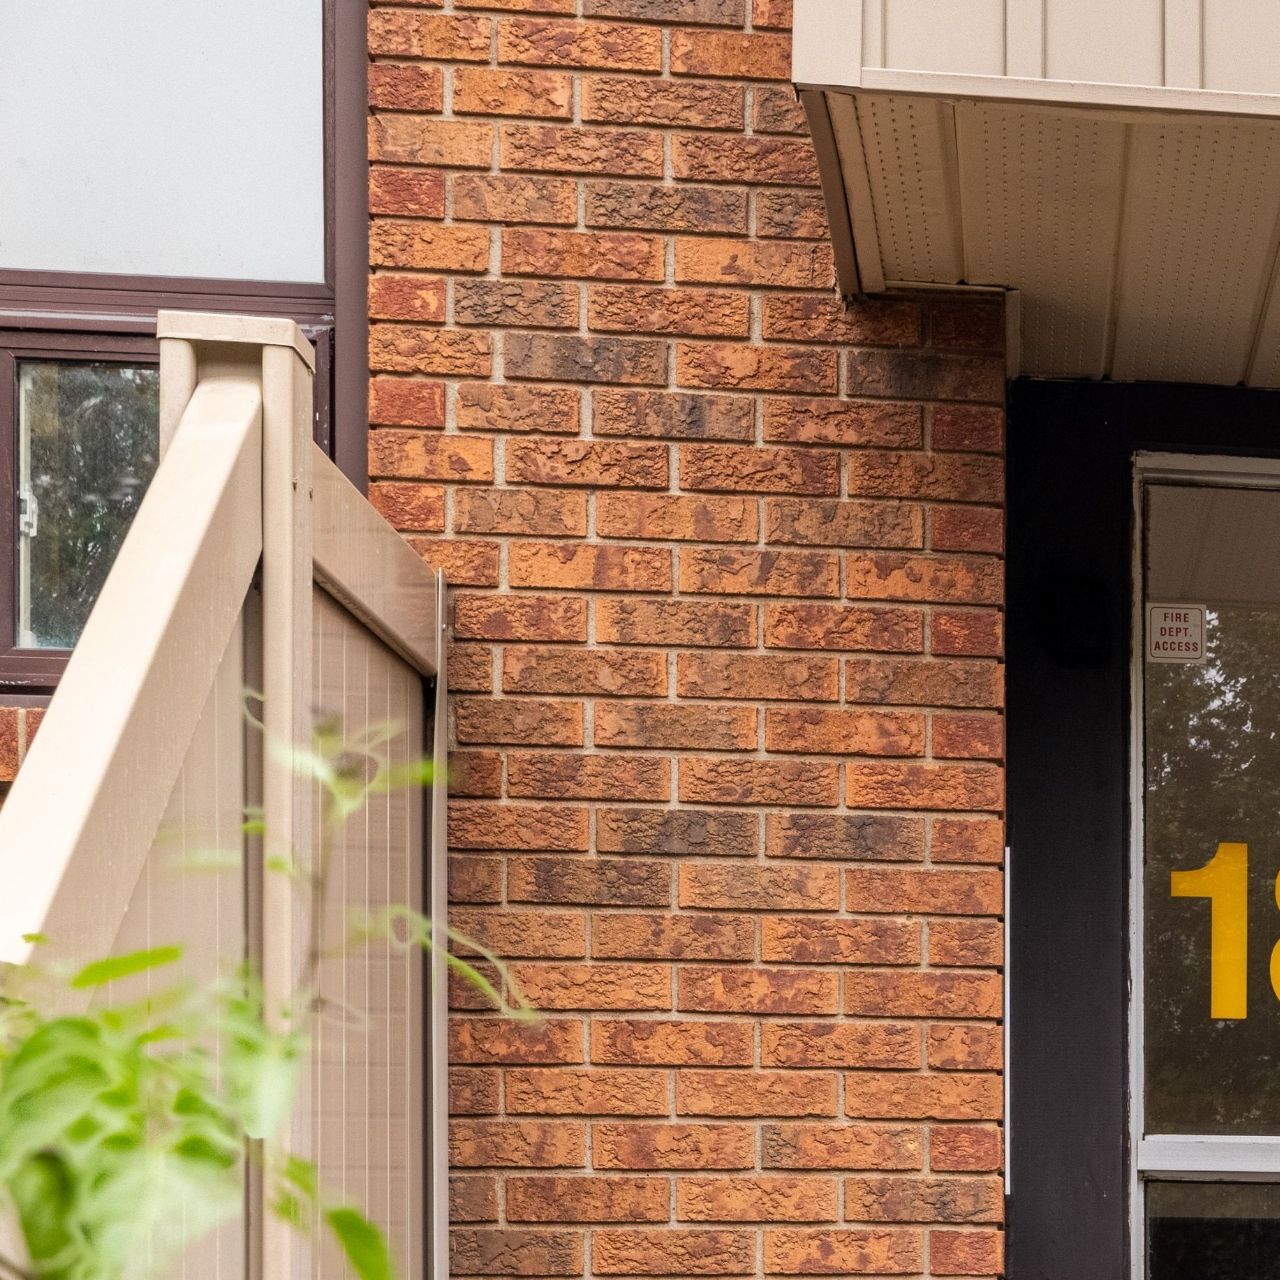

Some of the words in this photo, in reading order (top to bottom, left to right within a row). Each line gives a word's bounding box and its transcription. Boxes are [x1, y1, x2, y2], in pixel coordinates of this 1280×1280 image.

[1163, 612, 1190, 623] FIRE
[1160, 626, 1193, 638] DEPT.
[1153, 640, 1199, 652] ACCESS
